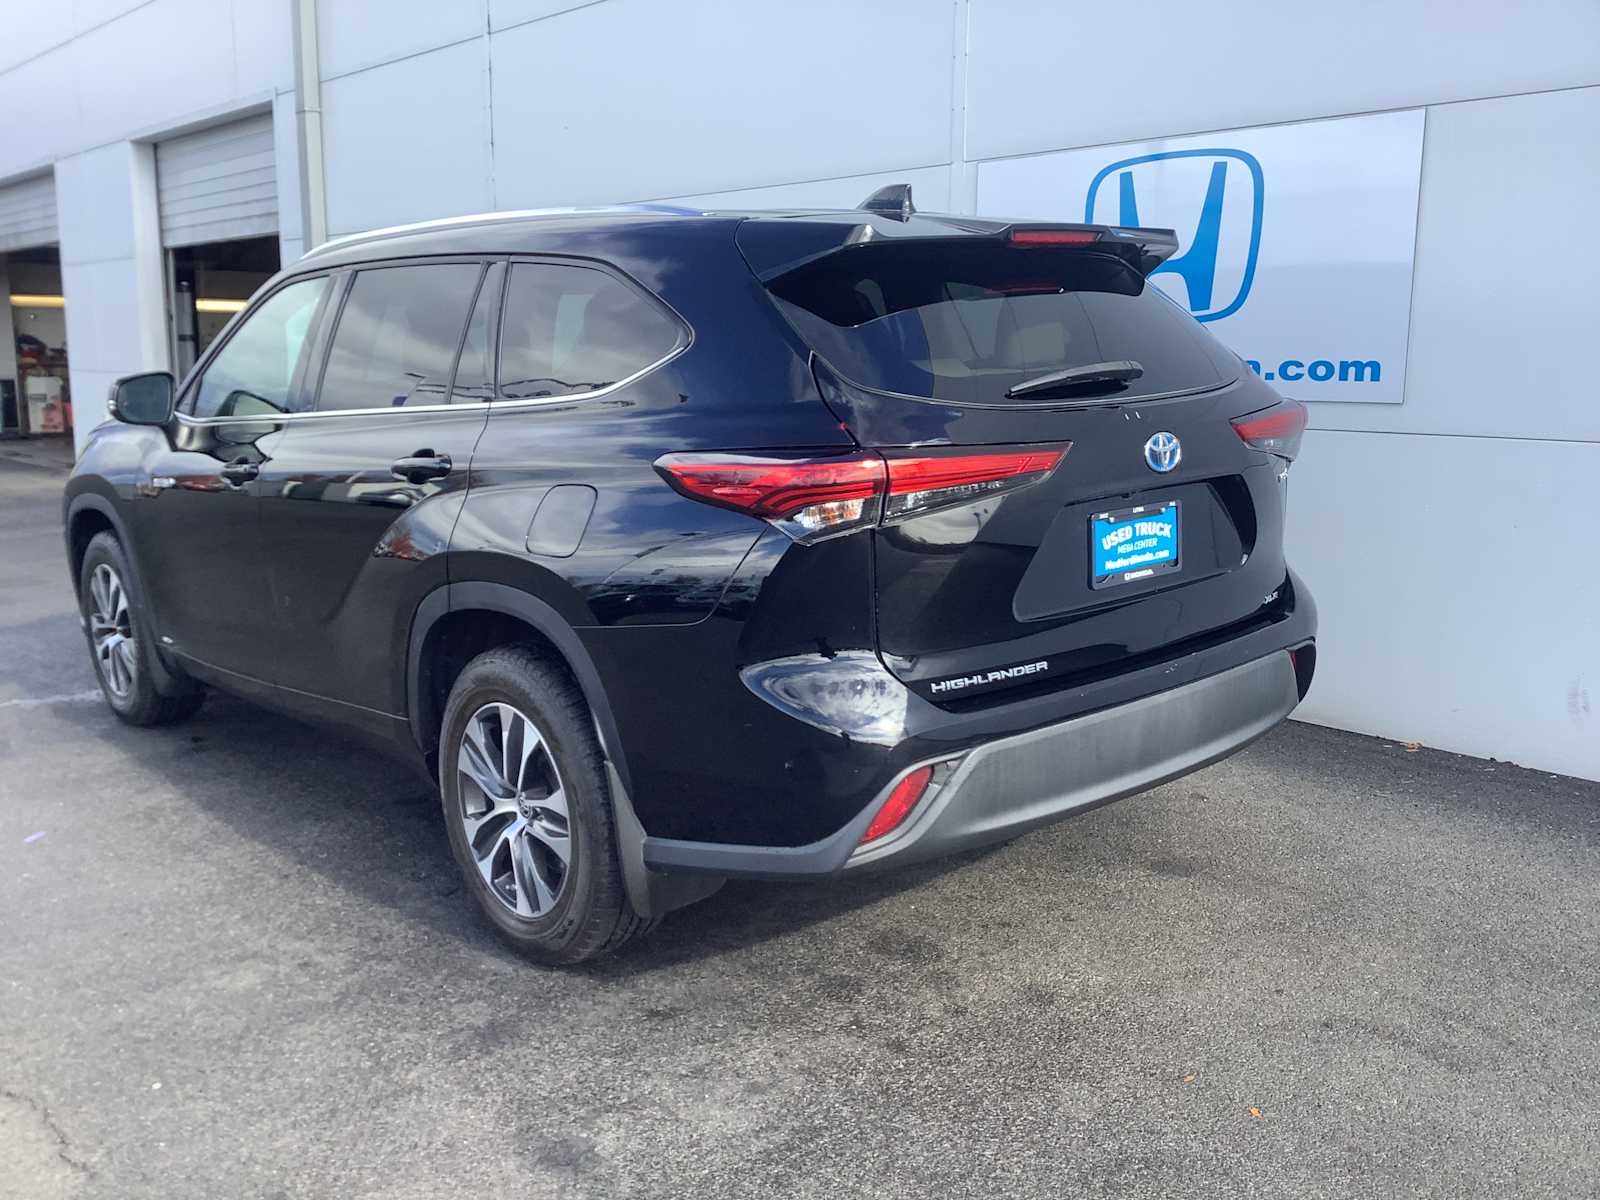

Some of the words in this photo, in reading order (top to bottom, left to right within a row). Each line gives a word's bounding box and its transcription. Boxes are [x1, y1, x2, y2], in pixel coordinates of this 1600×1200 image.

[1102, 525, 1132, 550] USED
[1134, 522, 1172, 538] TRUCK
[1134, 538, 1158, 550] CENTER
[930, 661, 1049, 694] HIGHLANDER
